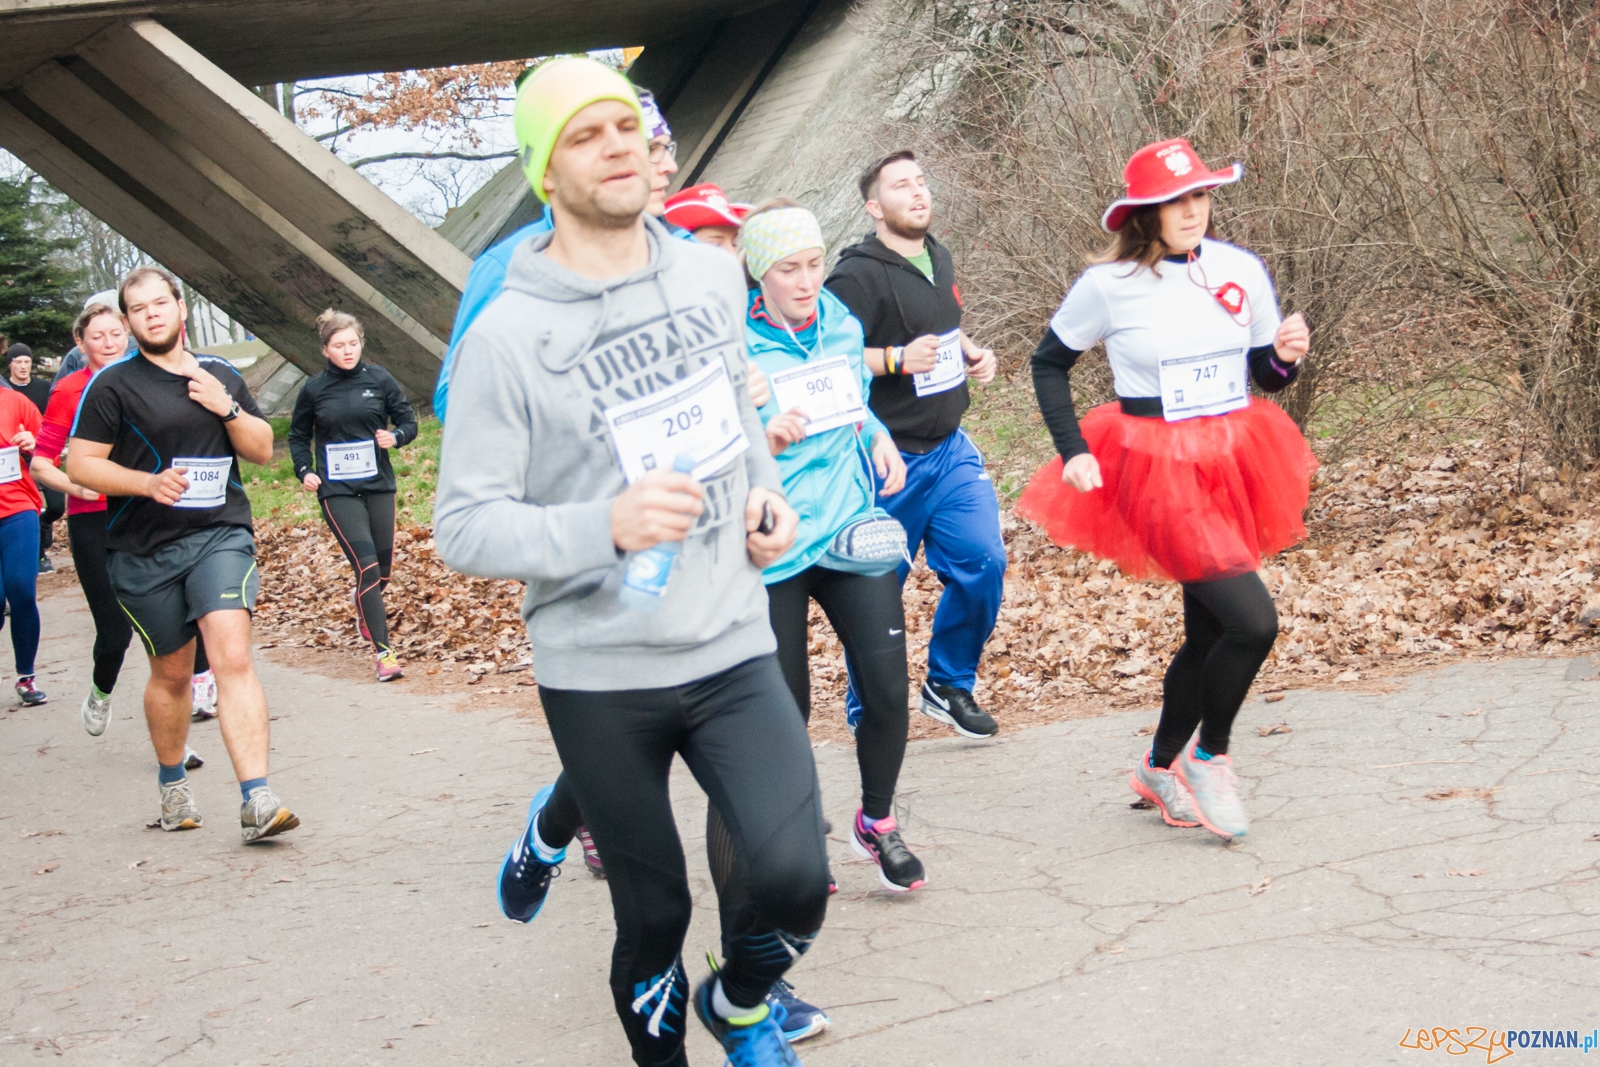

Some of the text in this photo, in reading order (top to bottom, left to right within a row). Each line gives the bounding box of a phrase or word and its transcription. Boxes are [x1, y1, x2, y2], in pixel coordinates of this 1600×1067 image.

[1192, 364, 1218, 382] 747
[806, 376, 833, 396] 900
[662, 404, 704, 438] 209
[344, 452, 360, 461] 491
[193, 470, 219, 482] 1084
